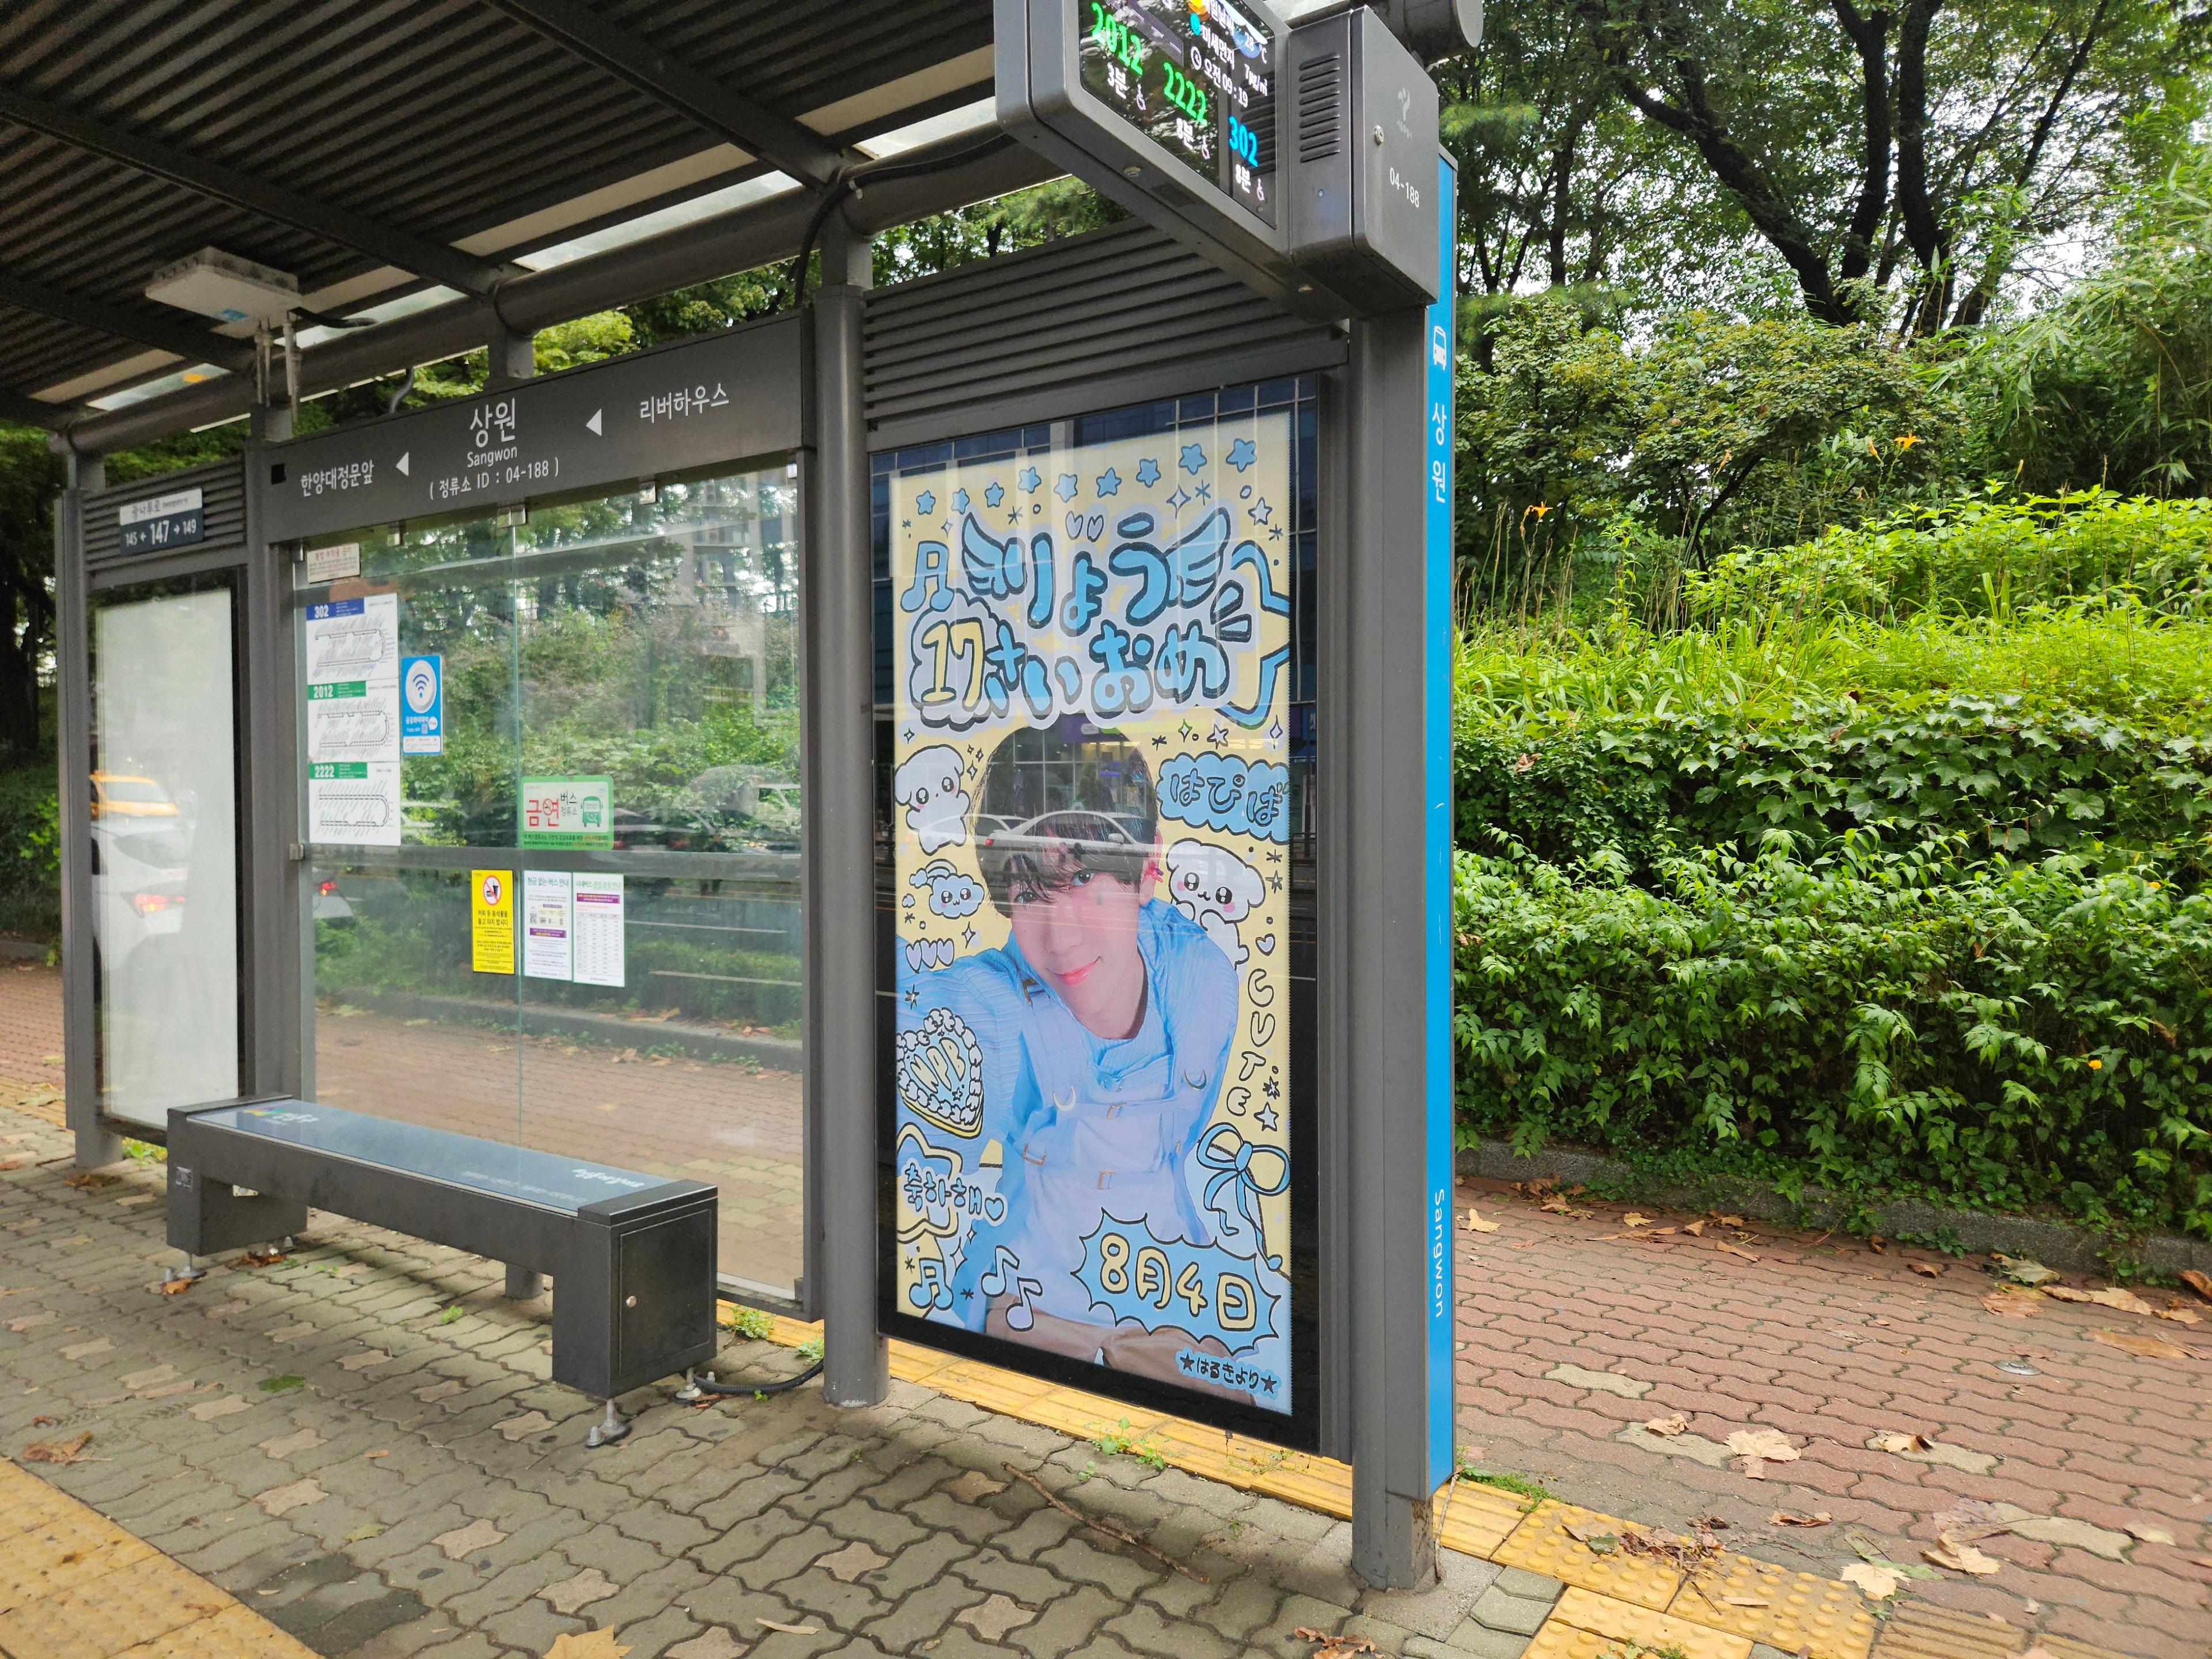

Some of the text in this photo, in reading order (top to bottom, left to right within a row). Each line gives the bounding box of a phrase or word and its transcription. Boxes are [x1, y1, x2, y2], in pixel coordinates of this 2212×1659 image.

[1090, 2, 1143, 75] 2012
[1201, 25, 1234, 70] 미세먼지
[1107, 62, 1130, 100] 3분
[1204, 58, 1221, 88] 오전
[1164, 62, 1207, 126] 2222
[1176, 118, 1195, 150] 8분
[1228, 116, 1259, 167] 302
[1236, 164, 1251, 194] 8분
[1389, 166, 1419, 208] 04-188
[639, 382, 730, 423] 리버하우스
[469, 398, 517, 449] 상원
[467, 445, 518, 468] Sangwon
[1431, 402, 1447, 503] 상원
[300, 460, 374, 498] 한양대정문앞
[476, 468, 490, 488] ID
[506, 461, 549, 484] 04-188
[149, 520, 169, 545] 147
[182, 518, 196, 535] 149
[314, 604, 329, 619] 302
[313, 685, 334, 699] 2012
[315, 764, 335, 778] 2222
[526, 798, 559, 827] 금연
[560, 790, 578, 805] 버스
[561, 806, 578, 817] 정류소
[1170, 767, 1290, 828] はぴば
[548, 878, 558, 887] 버스
[1226, 968, 1275, 1117] CUTE
[904, 1162, 982, 1215] 축하해
[1433, 1188, 1445, 1318] Sangwon
[1100, 1232, 1257, 1332] 8月4日
[1196, 1357, 1259, 1389] はるきより
